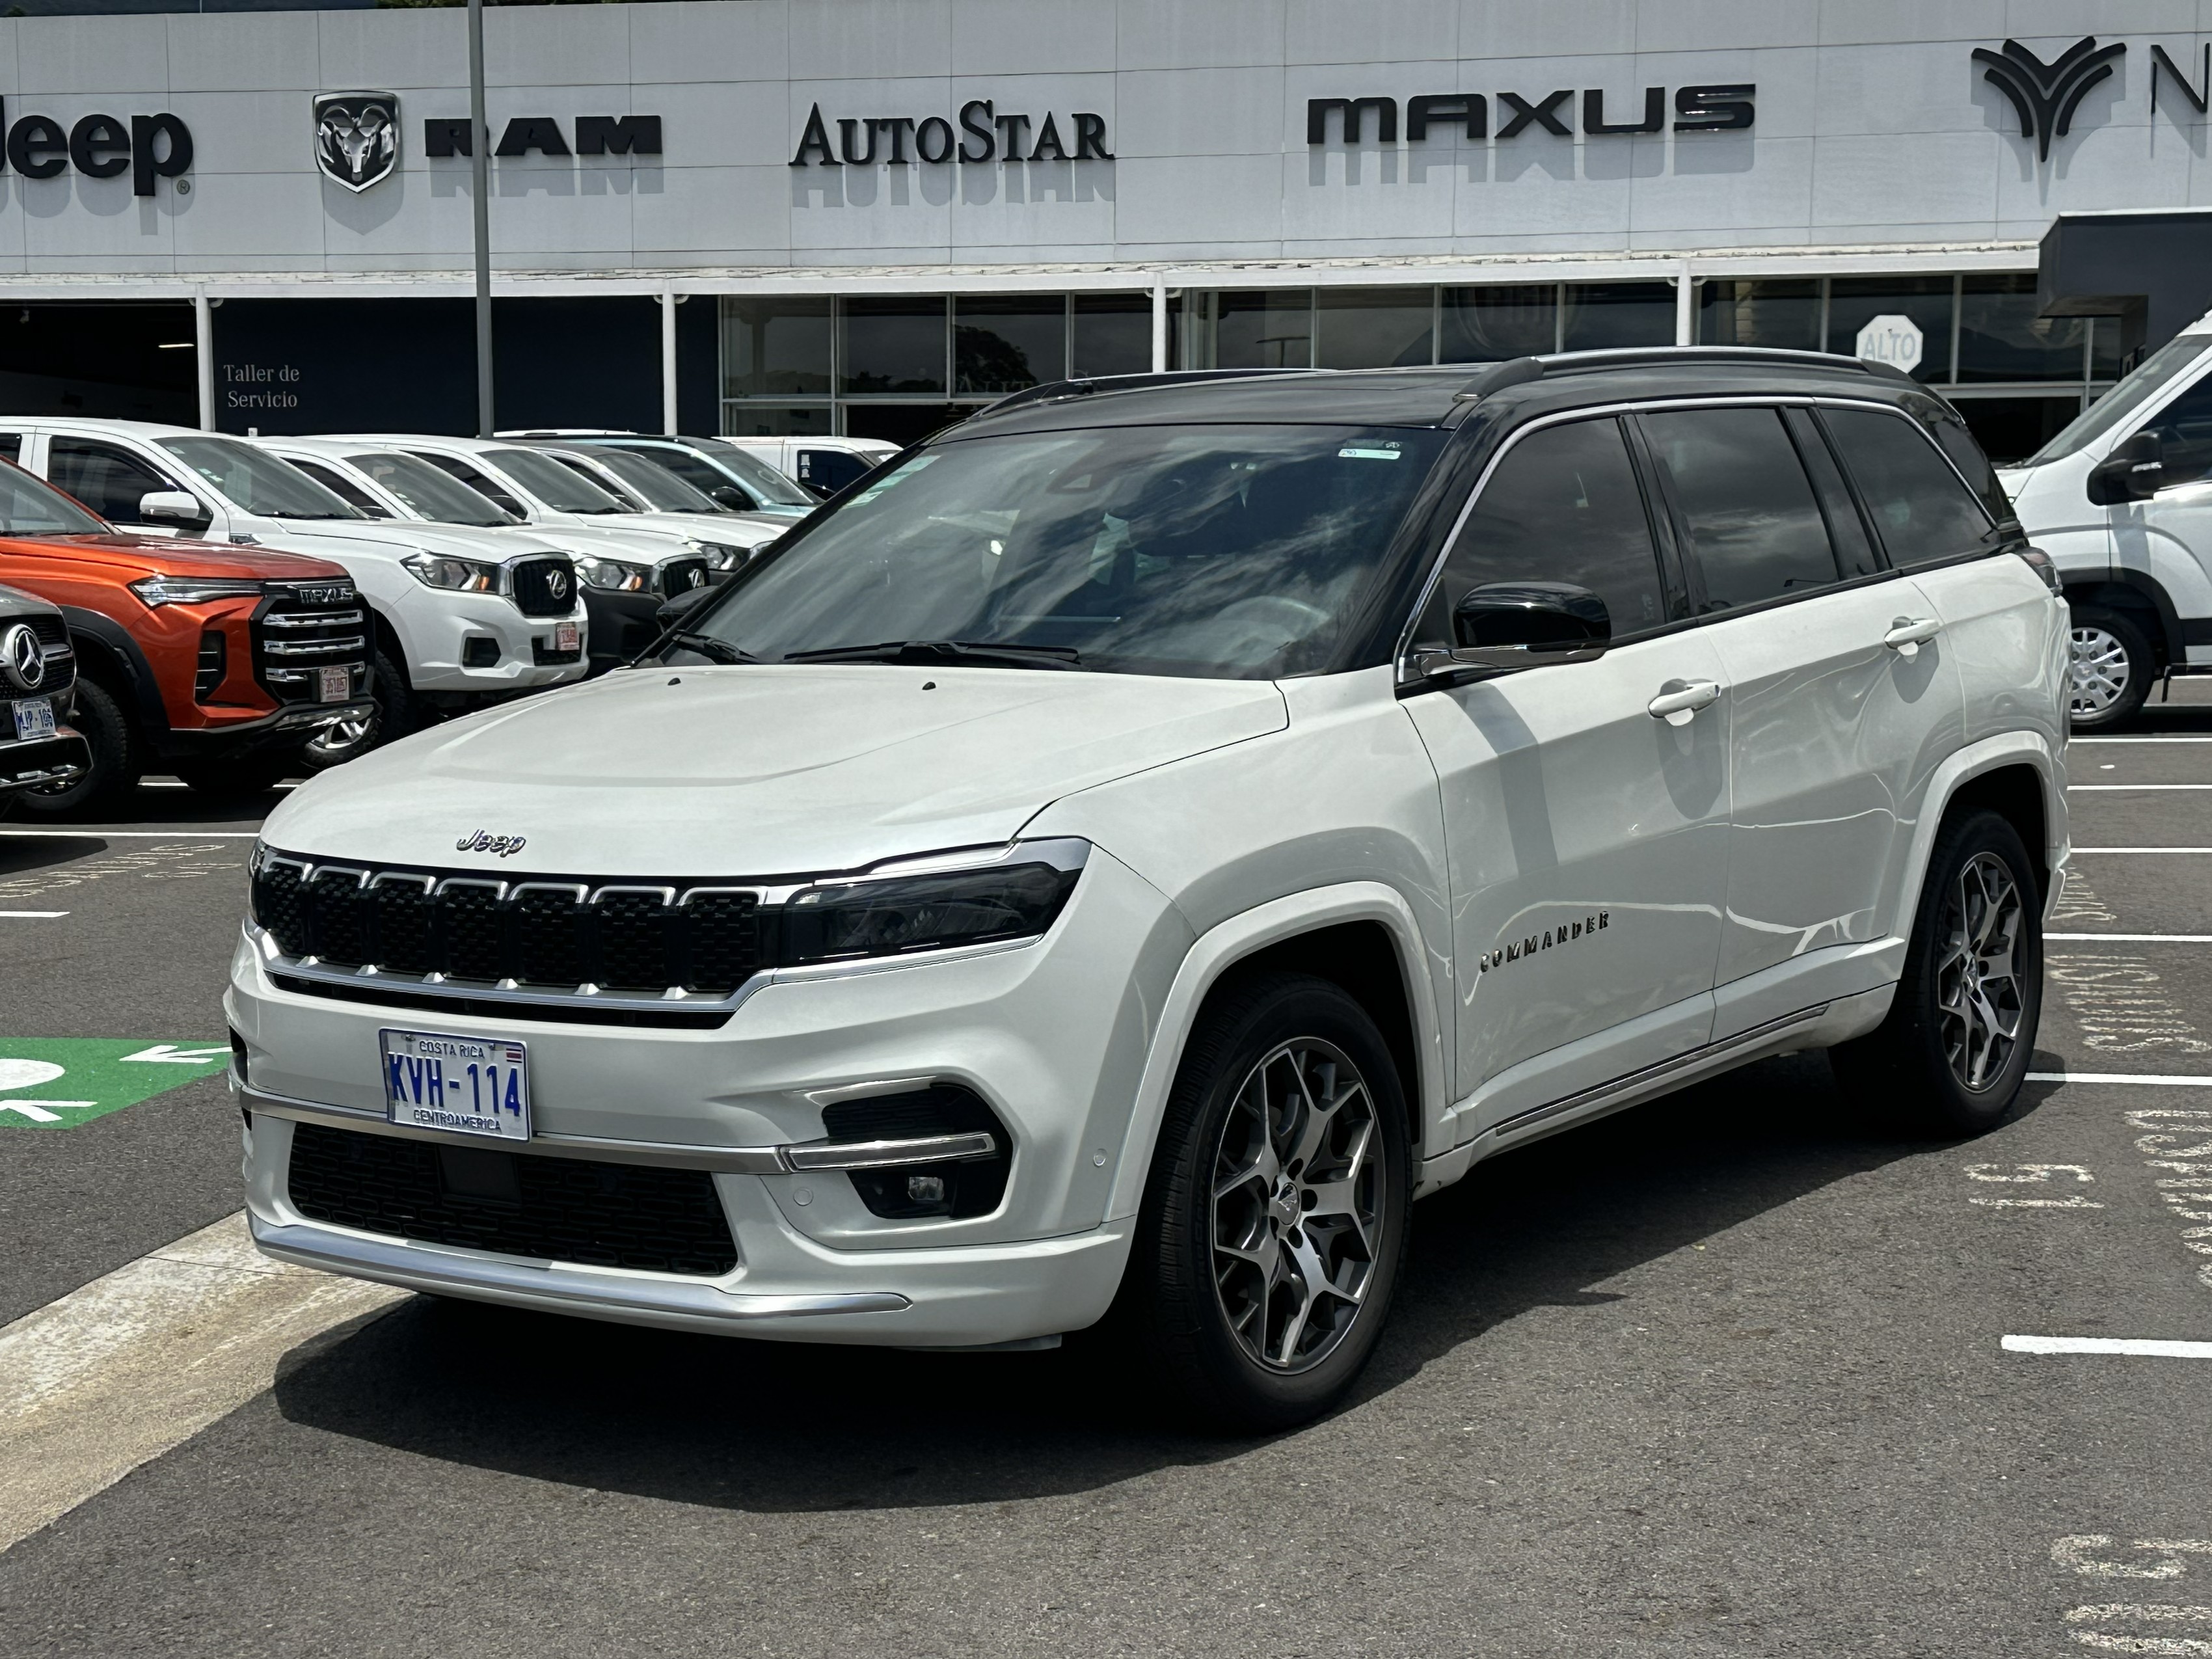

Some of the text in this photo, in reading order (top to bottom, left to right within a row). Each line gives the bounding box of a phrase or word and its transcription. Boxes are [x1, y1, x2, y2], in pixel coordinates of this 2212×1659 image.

[1307, 84, 1756, 144] MAXUS
[0, 94, 194, 196] eep
[425, 115, 663, 157] RAM
[1863, 332, 1916, 361] ALTO
[223, 364, 299, 381] Taller de
[228, 390, 297, 407] Servicio
[456, 829, 526, 858] Jeep
[1480, 911, 1610, 973] COMMANDER
[419, 1040, 485, 1059] COSTA RICA
[388, 1051, 521, 1117] KVH-114
[414, 1109, 502, 1133] CENTROAMERICA
